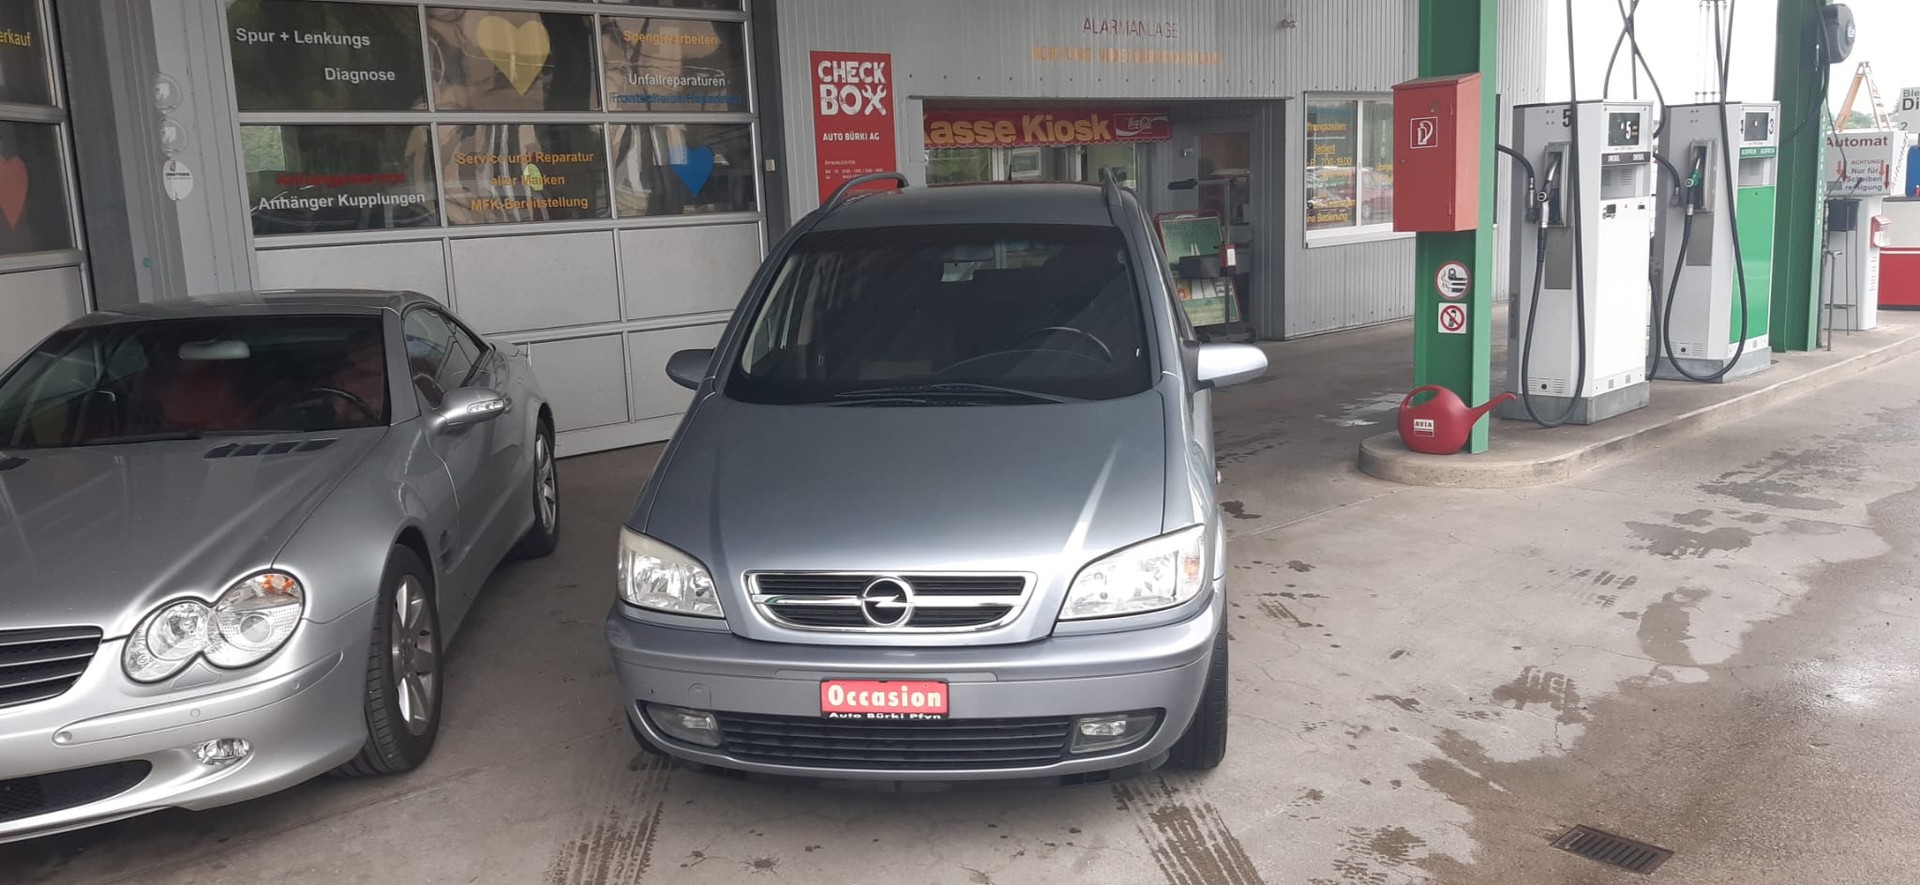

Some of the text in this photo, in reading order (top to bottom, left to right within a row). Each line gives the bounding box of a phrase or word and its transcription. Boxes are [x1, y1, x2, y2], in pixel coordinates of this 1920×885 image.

[1082, 17, 1178, 38] ALARMANLAGE
[235, 28, 371, 48] Spur + Lenkungs
[324, 67, 396, 84] Diagnose
[628, 73, 726, 88] Unfallreparaturen
[818, 60, 886, 84] CHECK
[819, 84, 887, 116] BOX
[1562, 109, 1571, 127] 5
[823, 131, 880, 141] AUTO BÜRKI AG
[924, 113, 1112, 145] asse Kiosk
[1827, 136, 1888, 148] Automat
[456, 152, 594, 165] Service und Reparatur
[490, 174, 565, 186] aller Marken
[258, 192, 425, 211] Anhänger Kupplungen
[828, 684, 942, 707] Occasion
